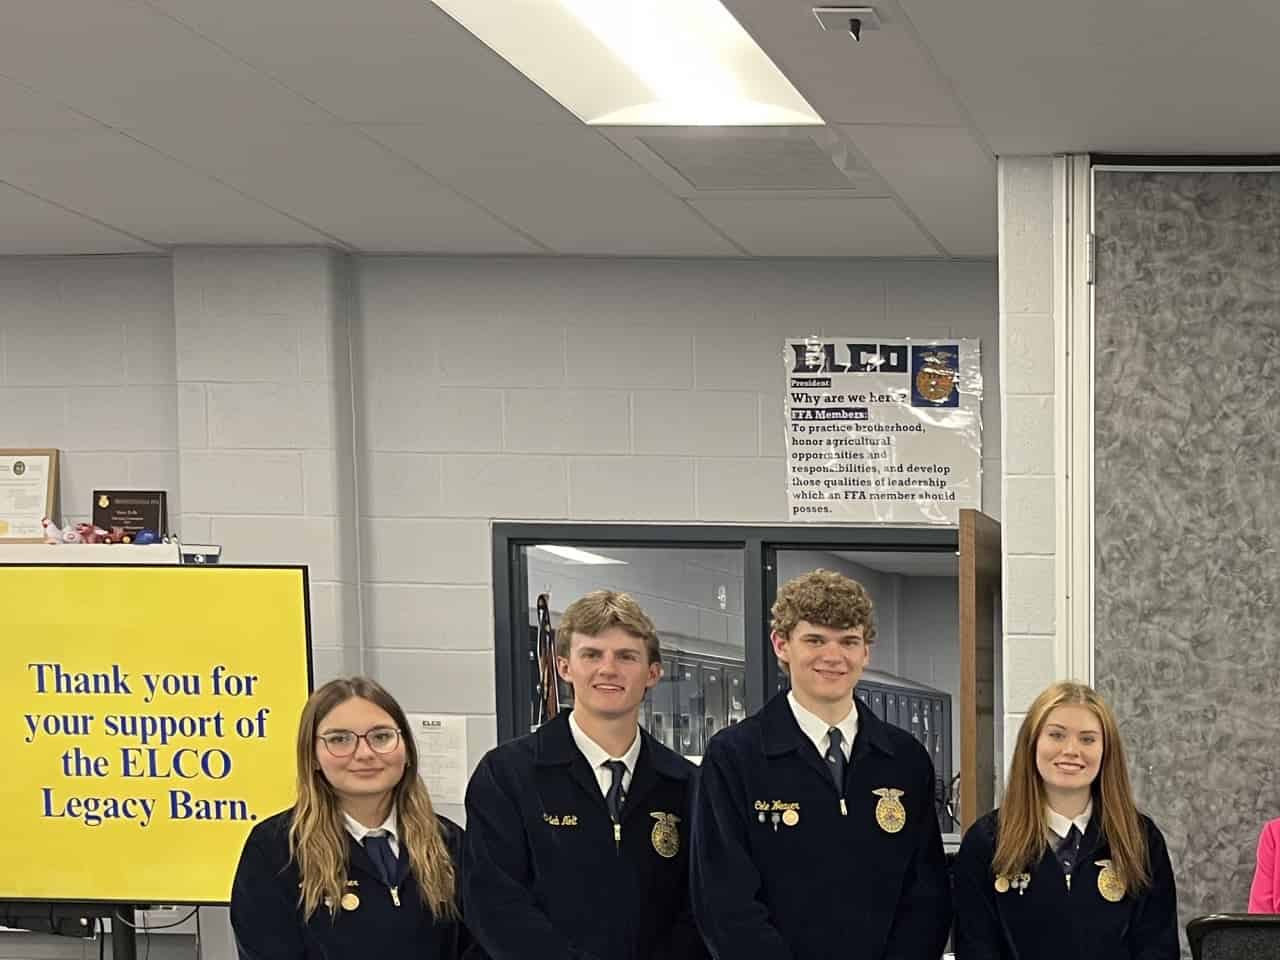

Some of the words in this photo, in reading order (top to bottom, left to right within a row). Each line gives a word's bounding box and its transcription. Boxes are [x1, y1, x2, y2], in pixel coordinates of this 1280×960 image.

[791, 344, 908, 373] ELCO
[791, 392, 820, 406] Why
[824, 394, 846, 403] are
[848, 394, 866, 403] we
[792, 424, 806, 432] To
[809, 424, 853, 435] practice
[855, 423, 926, 433] brotherhood,
[792, 437, 823, 446] honor
[826, 437, 891, 448] agricultural
[906, 464, 951, 475] develop
[792, 477, 821, 486] those
[823, 477, 872, 488] qualities
[874, 477, 886, 486] of
[888, 477, 947, 489] leadership
[792, 490, 825, 500] which
[844, 491, 866, 500] FFA
[869, 491, 915, 500] member
[918, 491, 956, 500] should
[792, 506, 833, 516] posses.
[28, 663, 132, 696] Thank
[143, 672, 201, 703] you
[211, 665, 260, 697] for
[24, 711, 94, 743] your
[104, 711, 225, 745] support
[235, 708, 270, 739] of
[61, 747, 109, 778] the
[120, 748, 232, 780] ELCO
[40, 787, 156, 827] Legacy
[168, 789, 258, 821] Barn.
